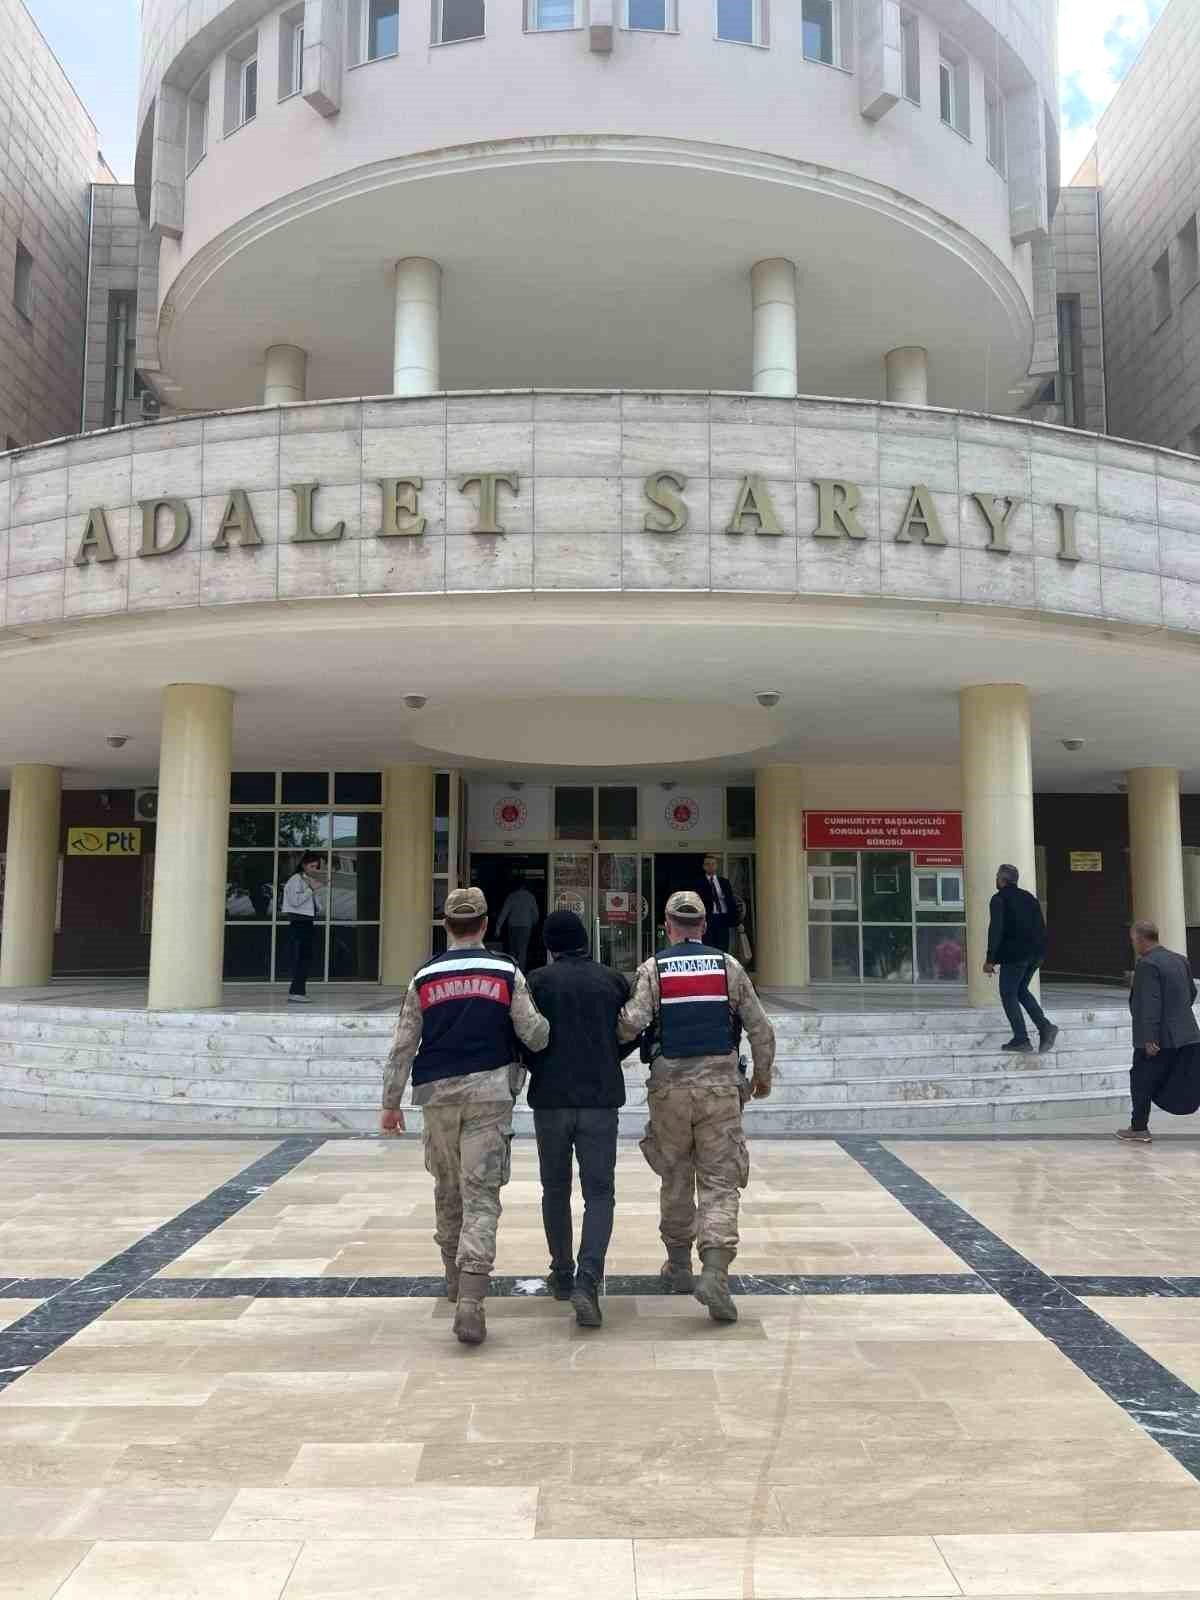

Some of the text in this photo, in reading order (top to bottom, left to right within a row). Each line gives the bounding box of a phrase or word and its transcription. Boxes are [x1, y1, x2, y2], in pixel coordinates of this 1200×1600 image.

[73, 470, 1082, 566] ADALET SARAYI
[106, 831, 136, 852] Ptt
[829, 828, 885, 836] SORGULAMA
[886, 828, 899, 836] VE
[664, 959, 719, 973] JANDARMA
[427, 978, 500, 1002] JANDARMA
